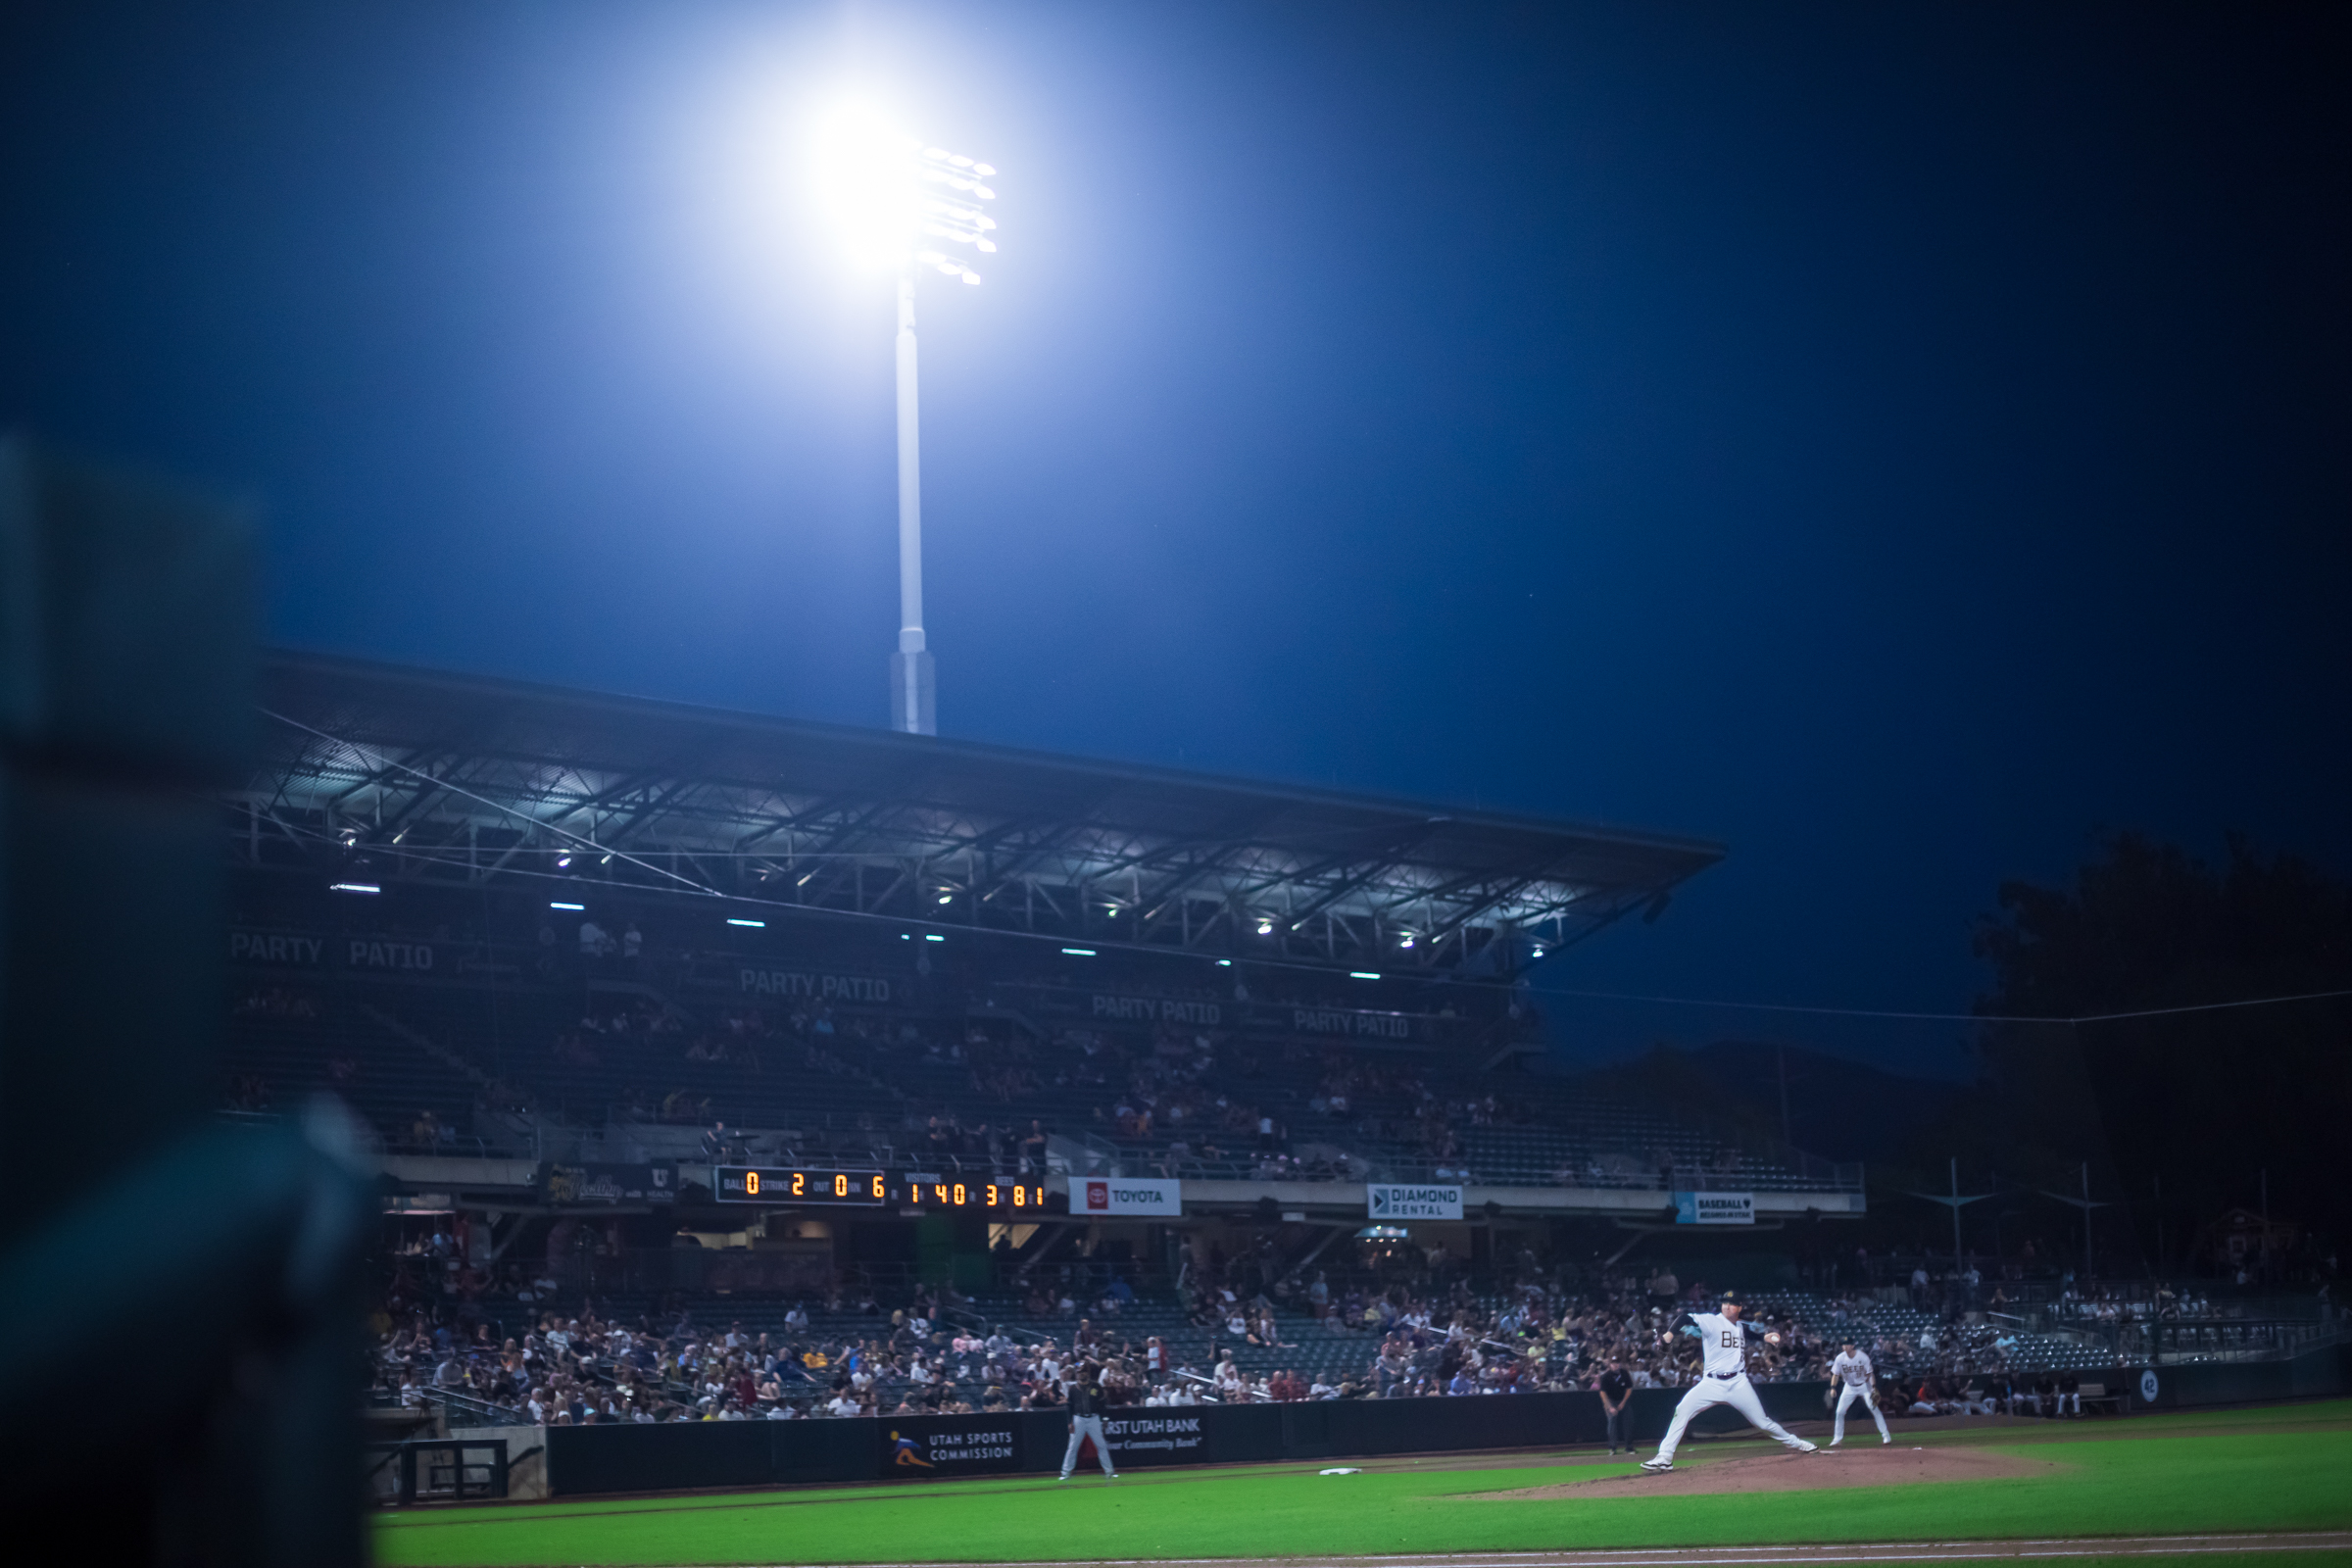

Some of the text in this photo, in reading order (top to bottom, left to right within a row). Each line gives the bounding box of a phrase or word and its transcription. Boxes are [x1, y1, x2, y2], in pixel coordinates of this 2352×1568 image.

[230, 932, 322, 963] PARTY
[350, 940, 433, 970] PATIO
[740, 968, 890, 1002] PARTY PATIO
[1092, 995, 1221, 1025] PARTY PATIO
[1294, 1009, 1409, 1038] PARTY PATIO
[723, 1178, 746, 1191] BALL
[746, 1171, 760, 1195] 0
[760, 1179, 790, 1192] STRIKE
[792, 1172, 805, 1196] 2
[812, 1181, 830, 1193] OUT
[835, 1174, 848, 1197] 0
[872, 1175, 885, 1199] 6
[1112, 1190, 1163, 1203] TOYOTA
[1392, 1189, 1457, 1203] DIAMOND
[1392, 1204, 1443, 1215] RENTAL
[1698, 1200, 1742, 1209] BASEBALL
[2144, 1378, 2155, 1394] 42
[1104, 1418, 1200, 1435] RST UTAH BANK
[929, 1431, 1012, 1446] UTAH SPORTS
[929, 1446, 1013, 1461] COMMISSION
